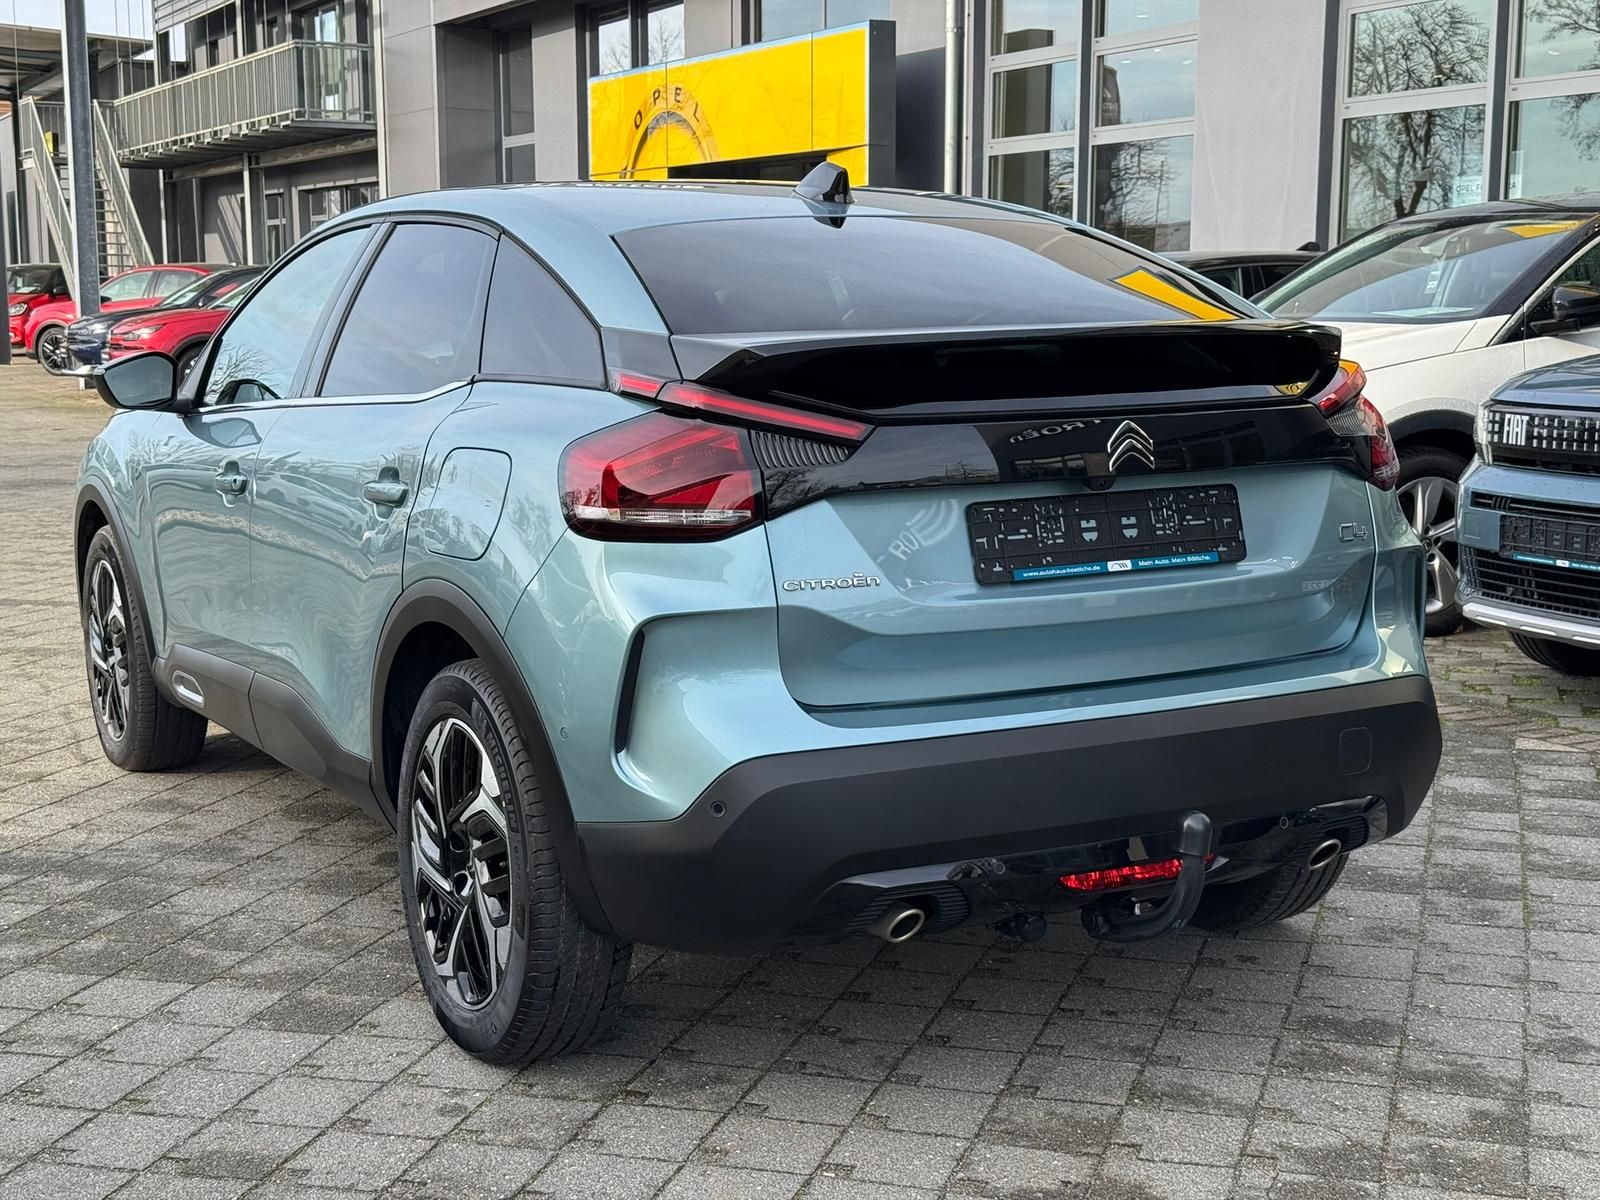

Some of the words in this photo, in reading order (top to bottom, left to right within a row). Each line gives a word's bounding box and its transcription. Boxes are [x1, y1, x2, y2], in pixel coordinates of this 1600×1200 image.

[634, 87, 700, 130] OPEL
[1502, 413, 1530, 446] FIAT
[1339, 522, 1368, 543] C4
[1023, 565, 1100, 577] www.autohaus-boettche.de
[1187, 554, 1212, 562] Böttche.
[485, 731, 519, 833] MICHELIN
